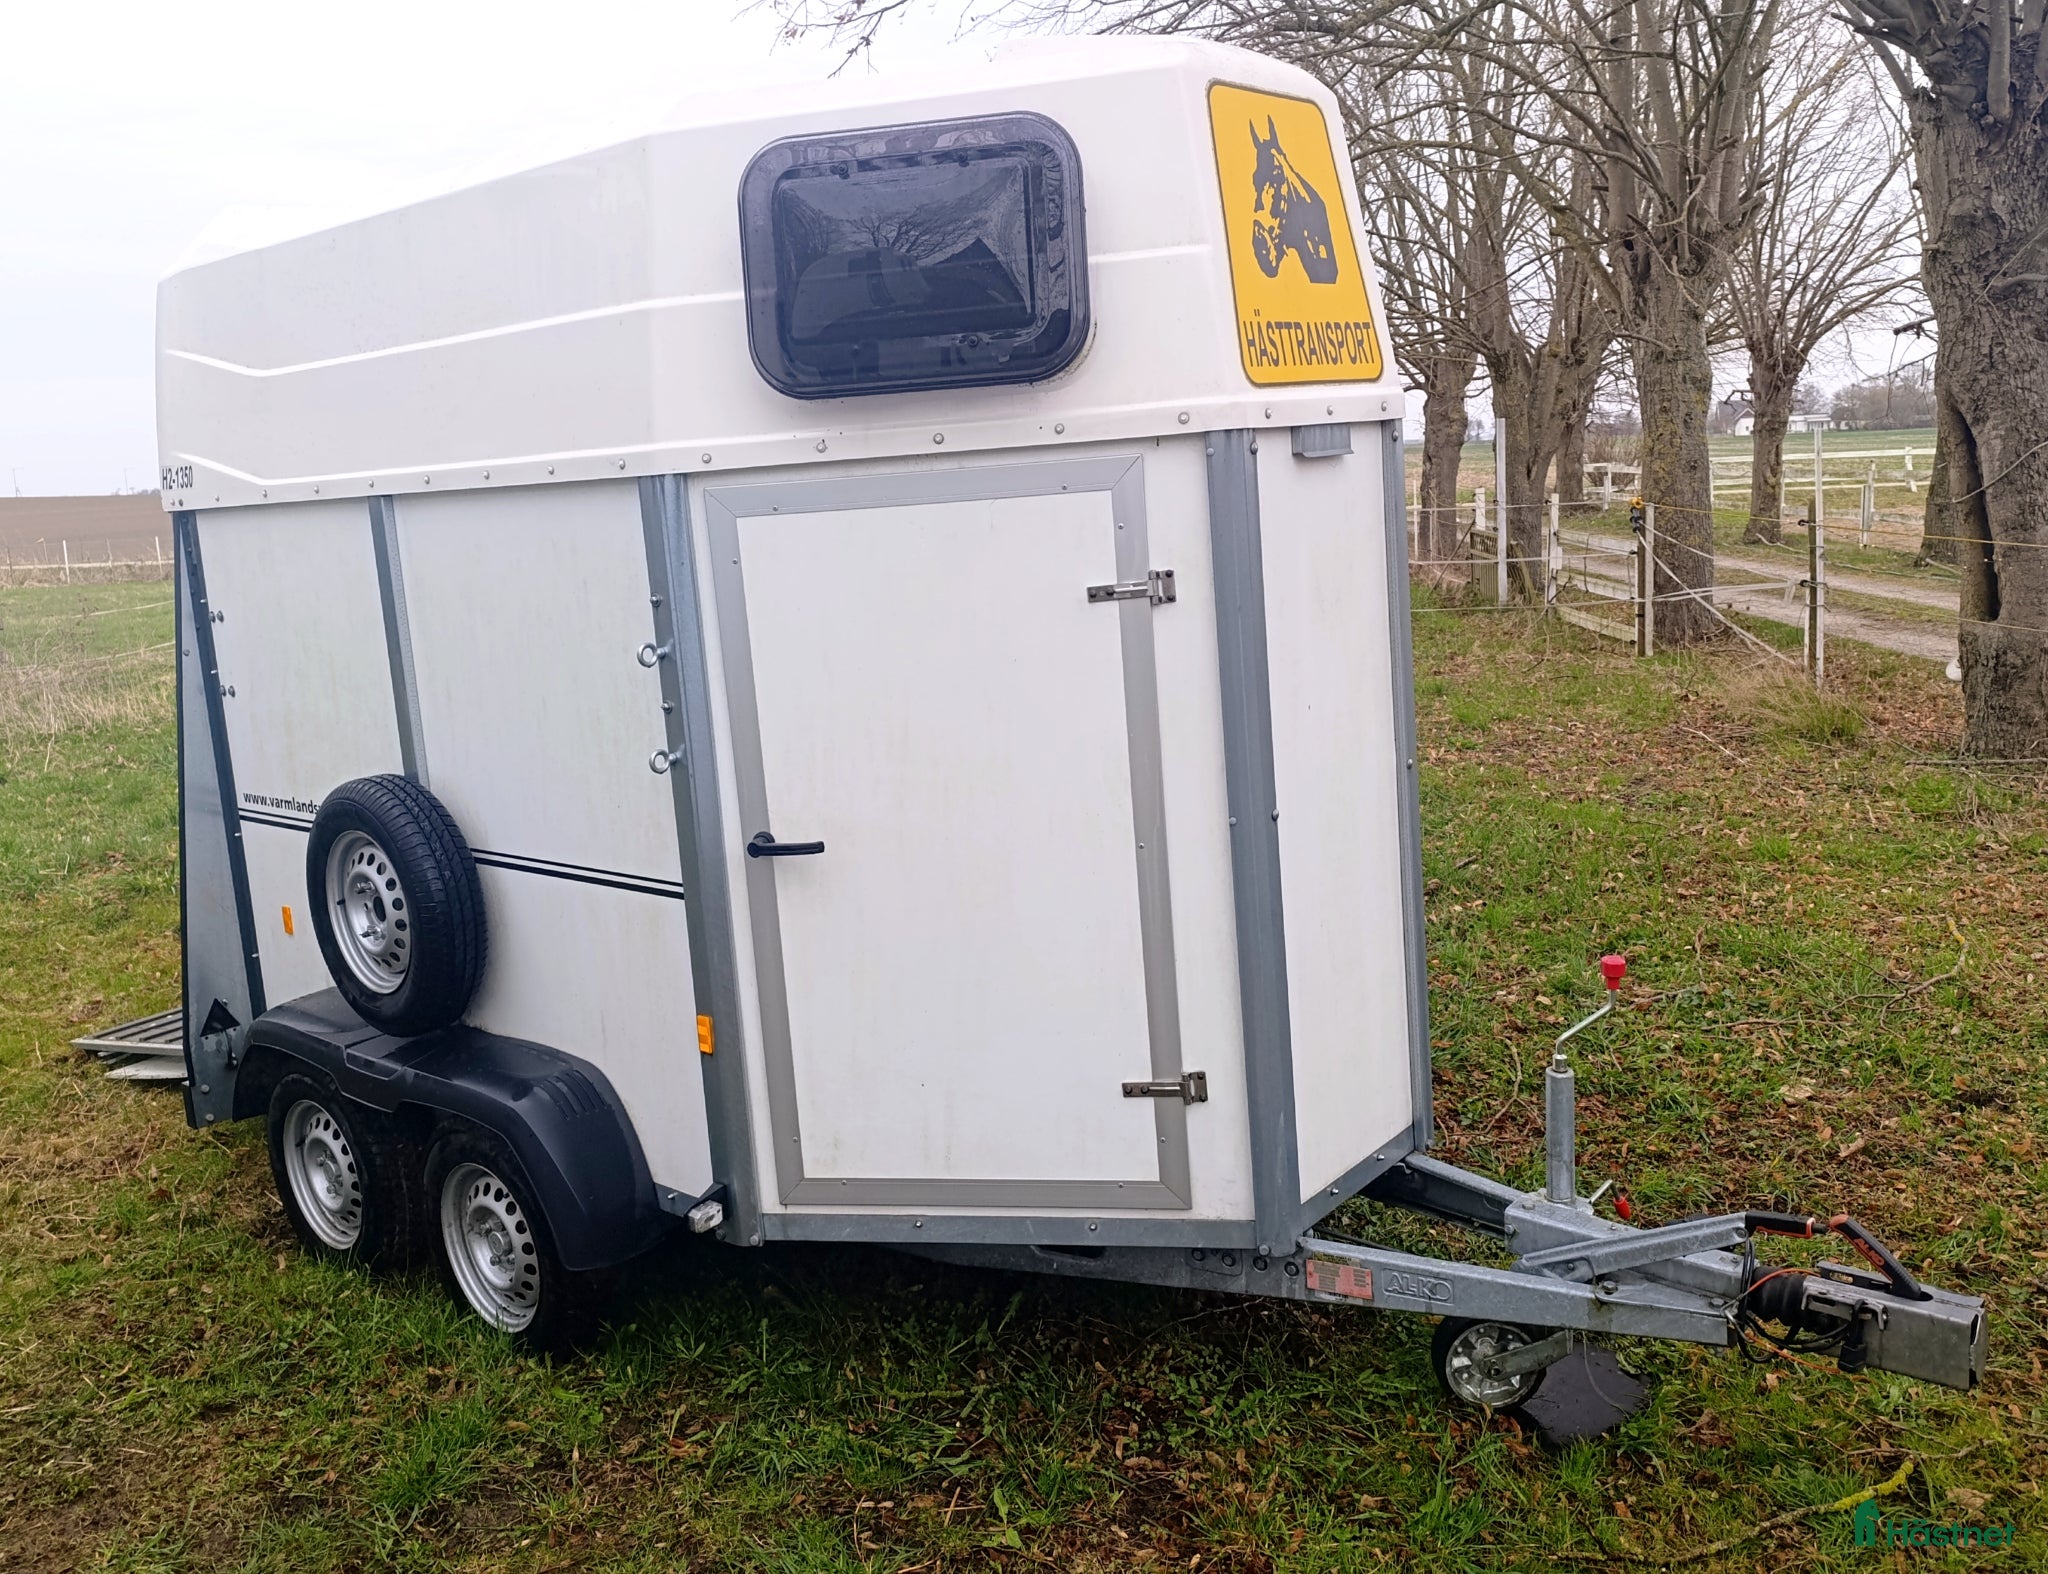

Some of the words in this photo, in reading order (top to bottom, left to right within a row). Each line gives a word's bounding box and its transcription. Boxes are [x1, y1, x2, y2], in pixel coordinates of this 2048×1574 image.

[1243, 308, 1375, 367] HÄSTTRANSPORT
[162, 465, 193, 490] H2-1350
[243, 792, 320, 814] www.varmlands
